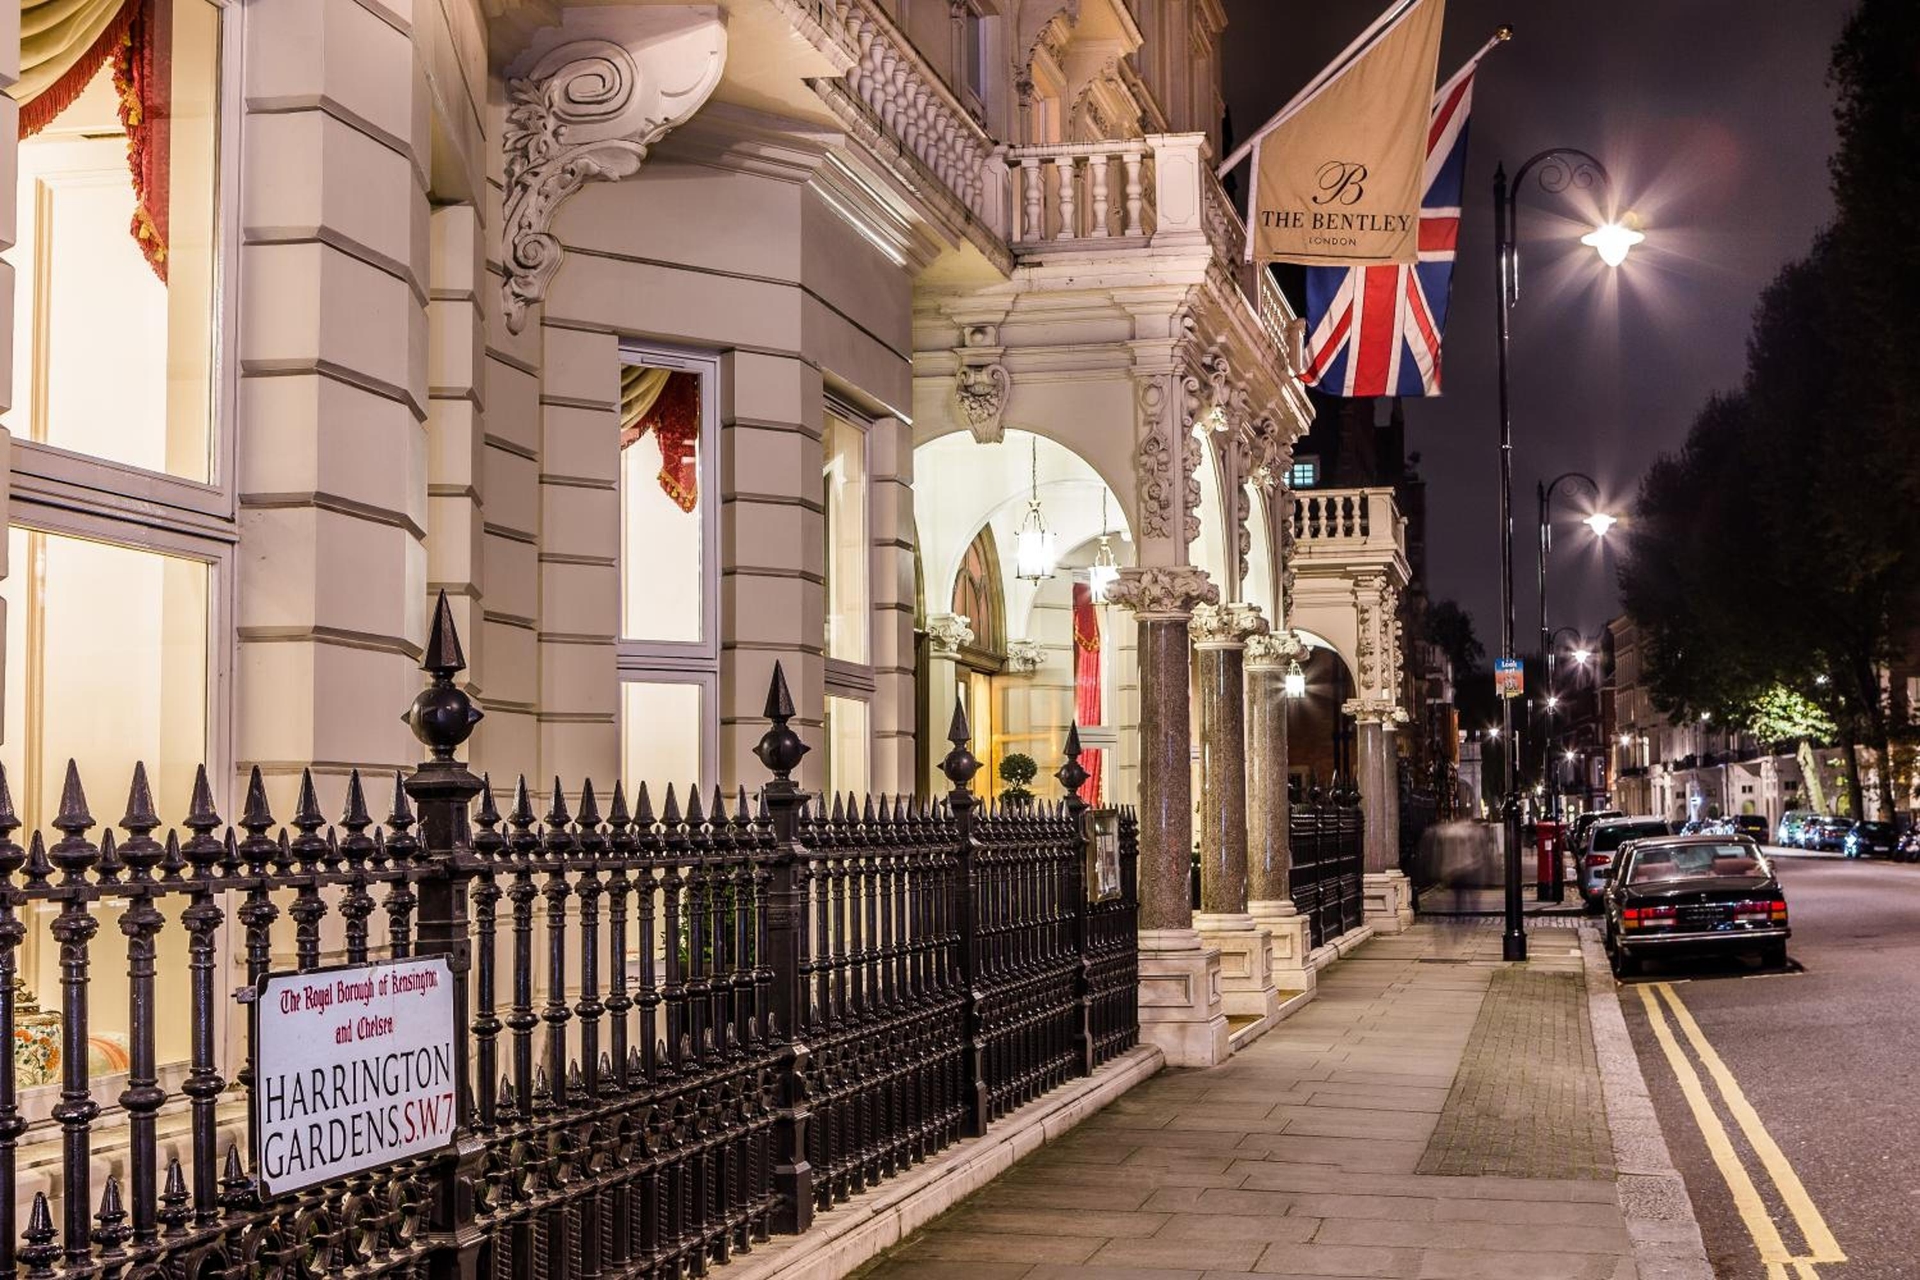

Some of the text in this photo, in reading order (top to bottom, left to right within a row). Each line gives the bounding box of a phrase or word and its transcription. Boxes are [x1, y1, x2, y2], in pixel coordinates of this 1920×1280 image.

[1261, 210, 1411, 232] THE BENTLEY
[1309, 237, 1357, 246] LONDON
[280, 970, 438, 1014] The Royal Borough of Kensington
[335, 1015, 393, 1044] and Chelsea
[265, 1043, 450, 1124] HARRINGTON
[404, 1093, 453, 1144] S.W.7
